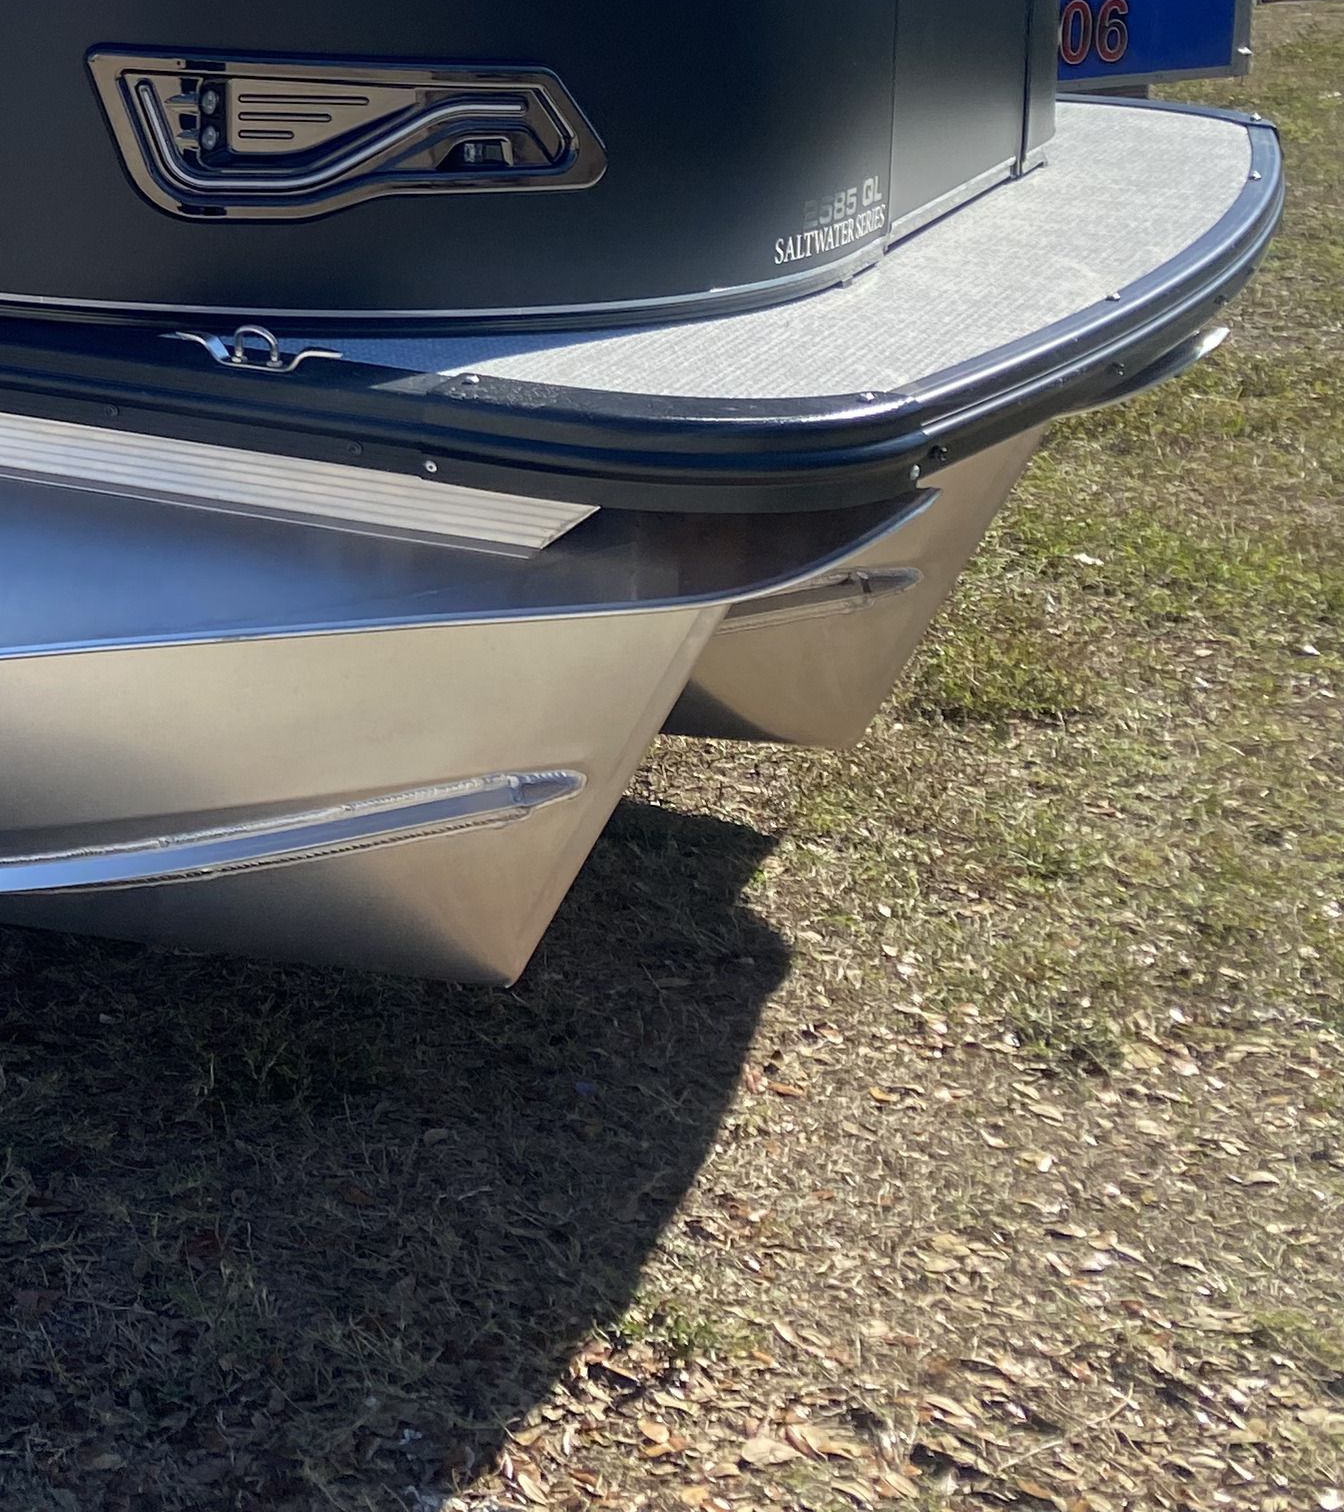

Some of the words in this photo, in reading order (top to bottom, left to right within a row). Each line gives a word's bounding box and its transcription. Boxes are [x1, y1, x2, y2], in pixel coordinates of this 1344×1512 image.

[862, 175, 883, 207] QL
[774, 218, 855, 265] SALTWATER
[855, 203, 887, 240] SERIES
